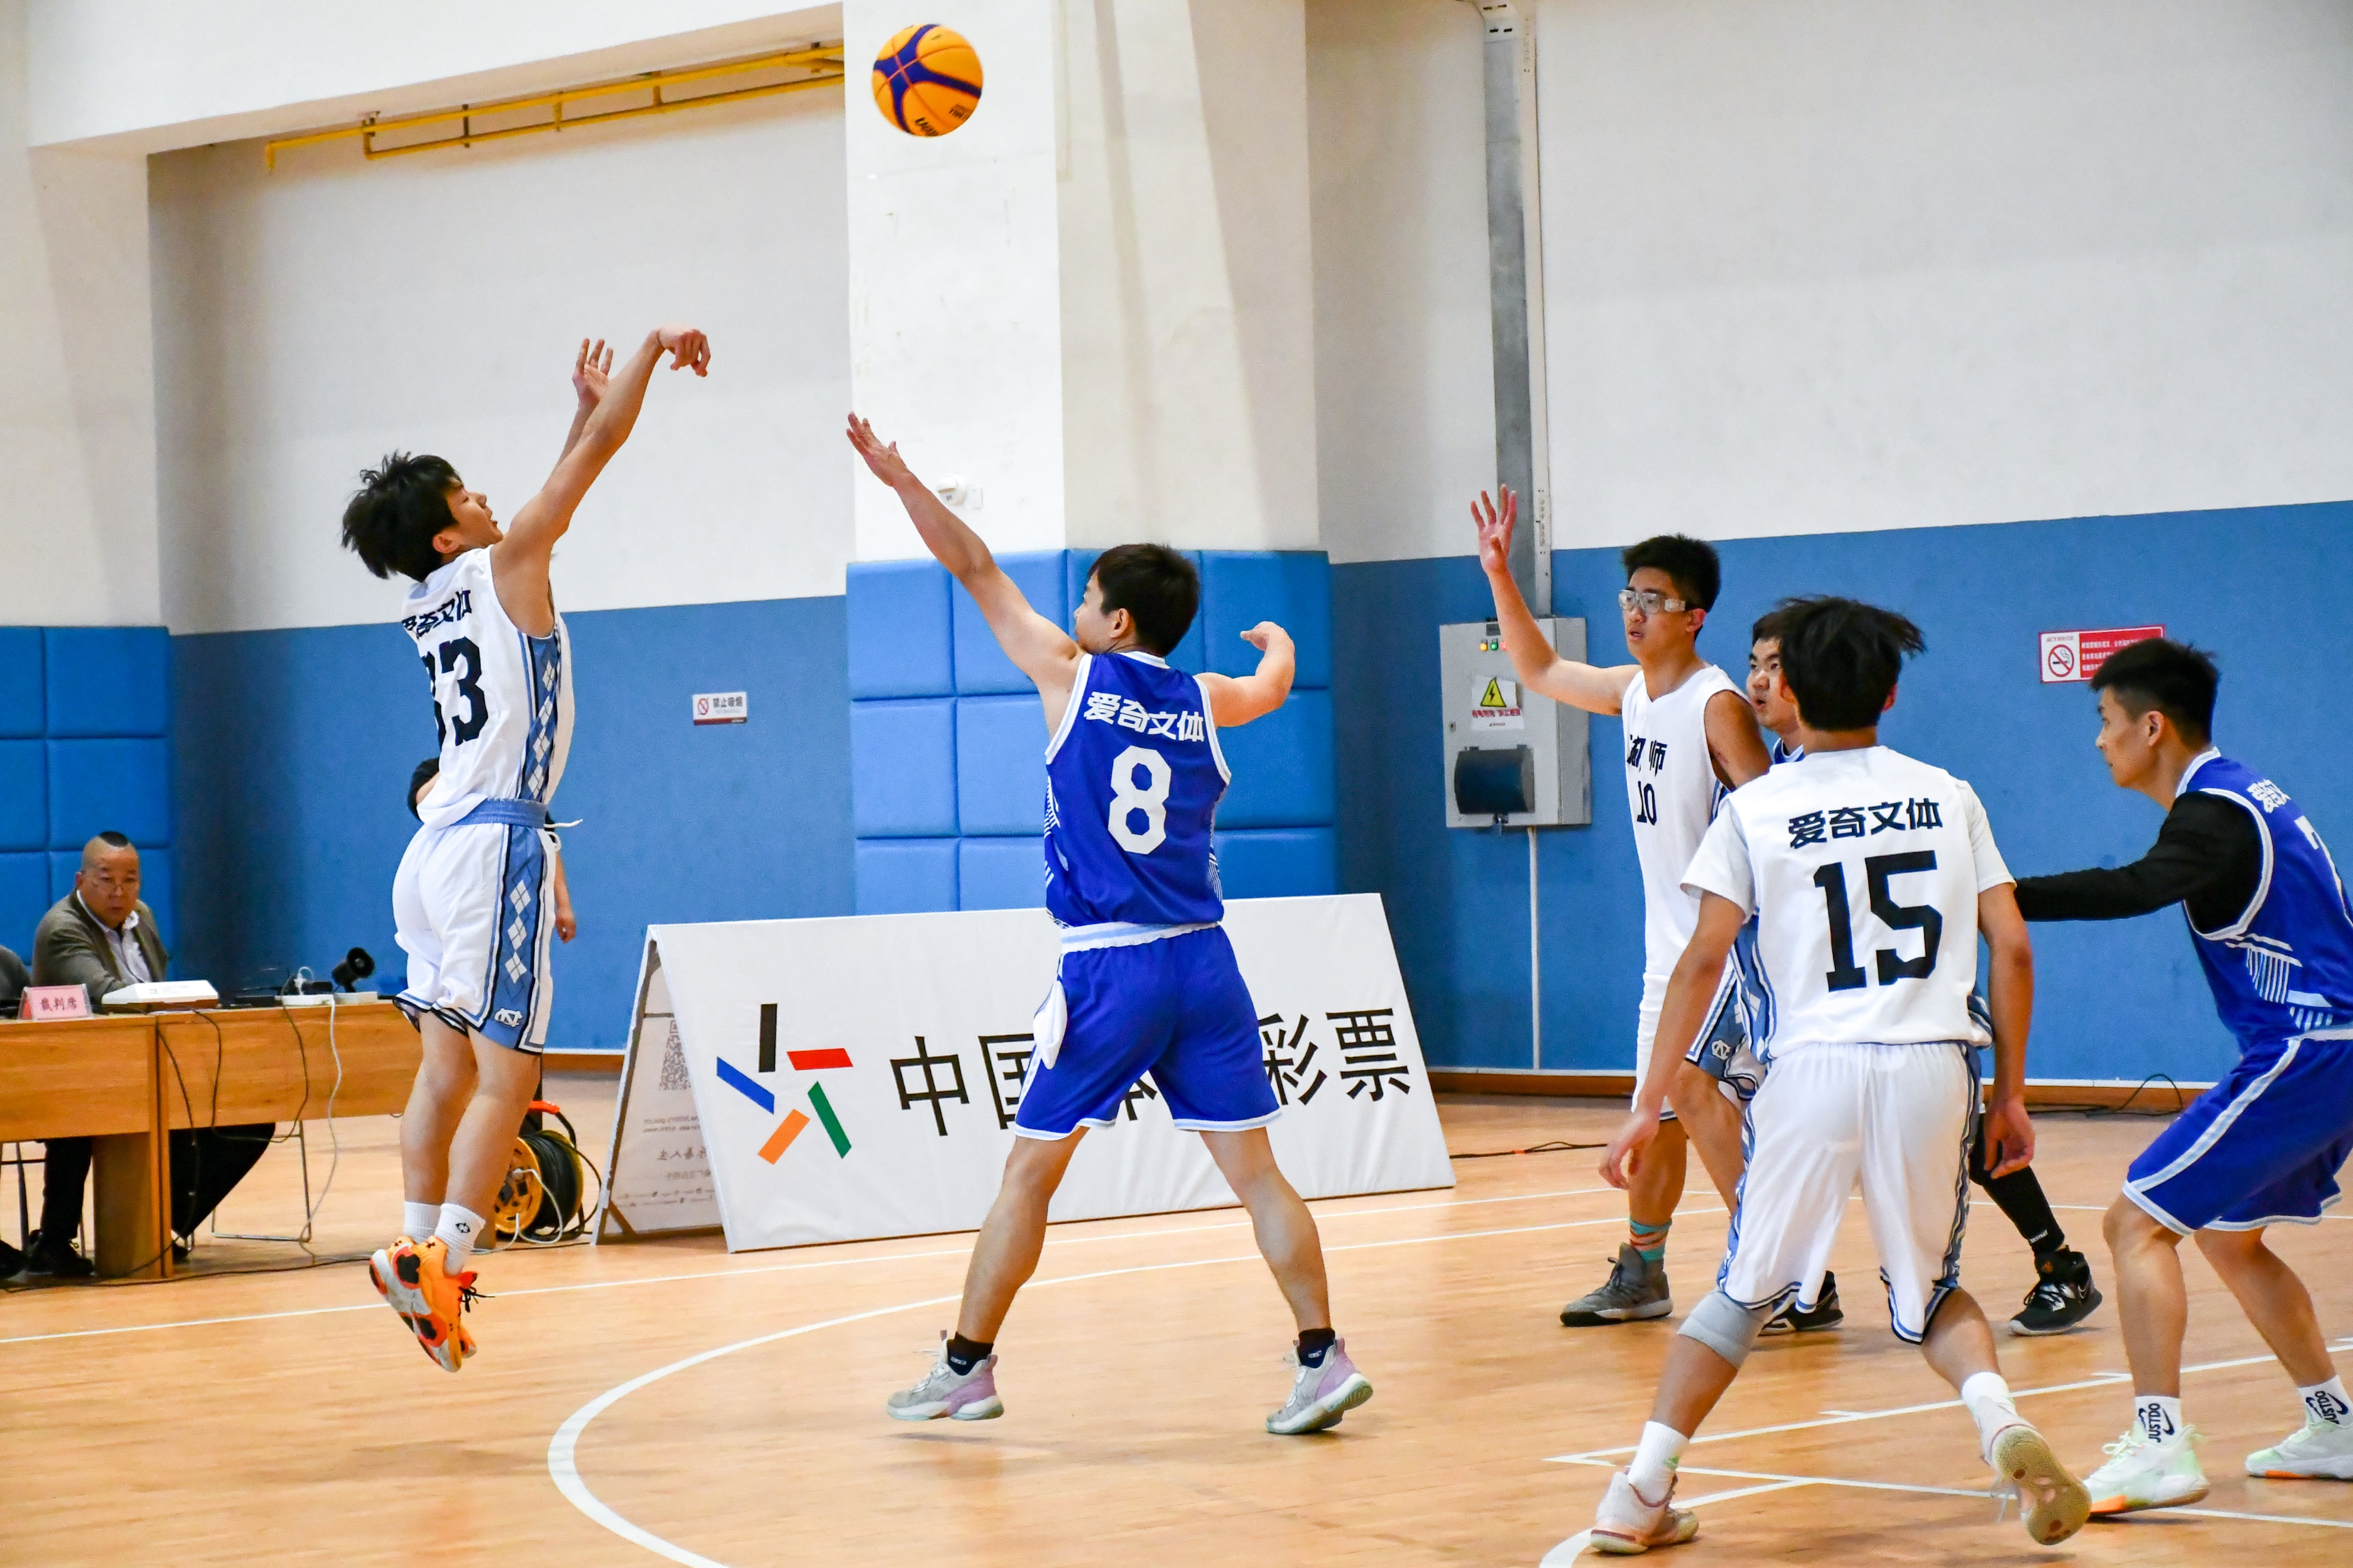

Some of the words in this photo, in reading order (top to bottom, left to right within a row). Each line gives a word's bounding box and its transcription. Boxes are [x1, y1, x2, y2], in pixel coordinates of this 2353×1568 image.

[1083, 691, 1205, 742] 爱奇文体
[1107, 745, 1172, 855] 8
[1637, 781, 1657, 826] 10
[1788, 797, 1944, 849] 爱奇文体
[1814, 850, 1942, 993] 15
[889, 1008, 1411, 1137] 中国彩票
